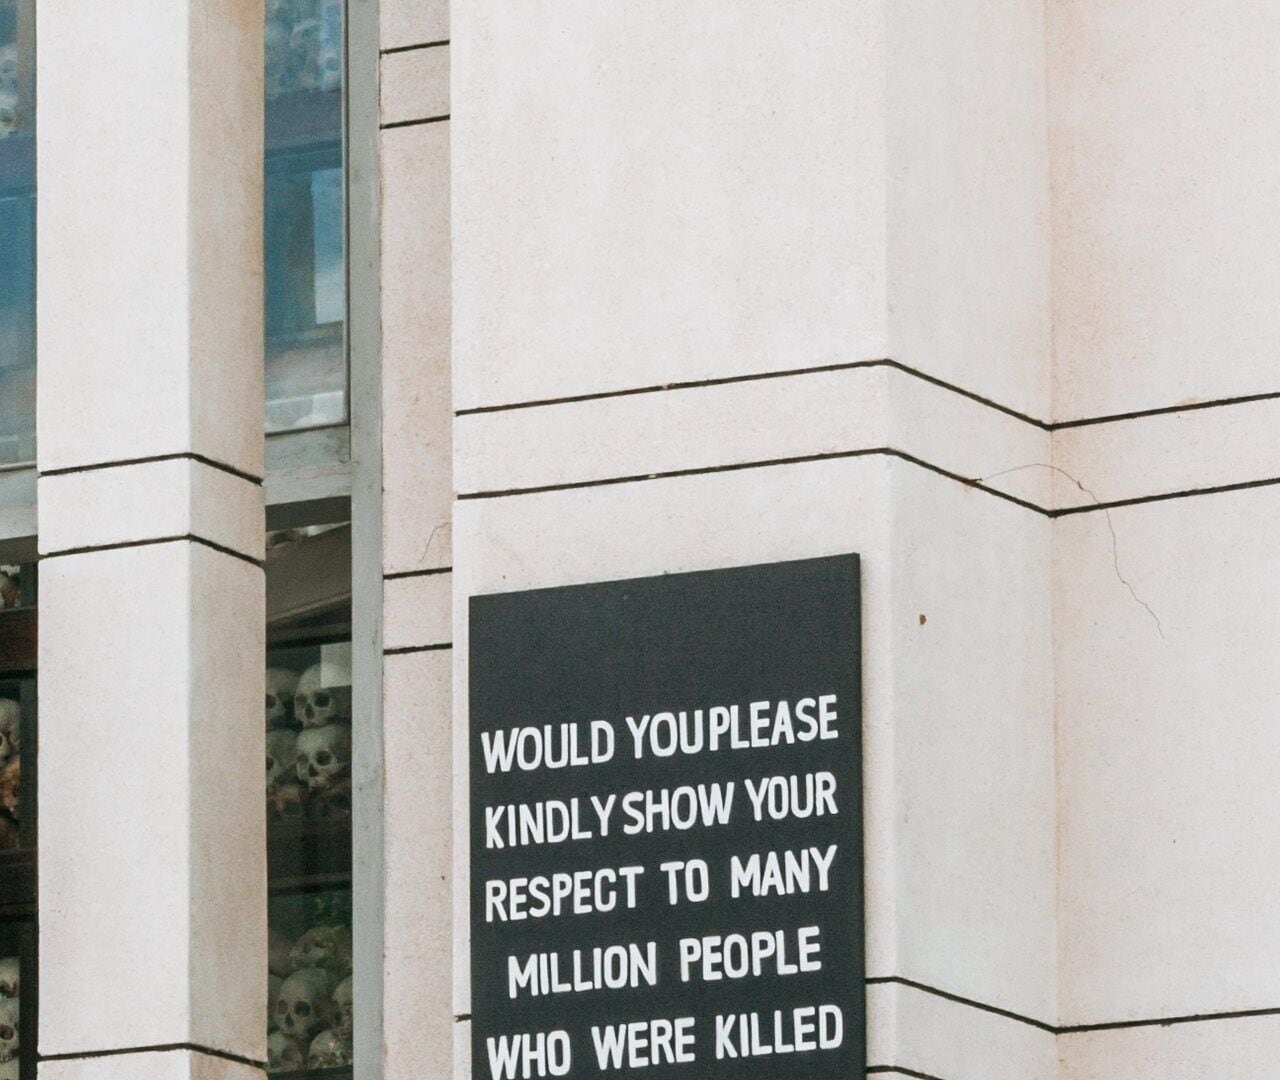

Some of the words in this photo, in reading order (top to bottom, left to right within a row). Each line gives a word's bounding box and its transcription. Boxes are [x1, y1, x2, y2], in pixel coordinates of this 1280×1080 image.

[481, 720, 614, 773] WOULD
[625, 710, 703, 759] YOU
[709, 694, 838, 751] PLEASE
[485, 794, 616, 849] KINDLY
[622, 782, 735, 834] SHOW
[744, 771, 838, 821] YOUR
[486, 866, 644, 922] RESPECT
[660, 859, 709, 908] TO
[731, 845, 837, 898] MANY
[508, 942, 657, 999] MILLION
[679, 926, 822, 981] PEOPLE
[487, 1030, 571, 1080] WHO
[591, 1017, 695, 1070] WERE
[716, 1004, 843, 1059] KILLED
